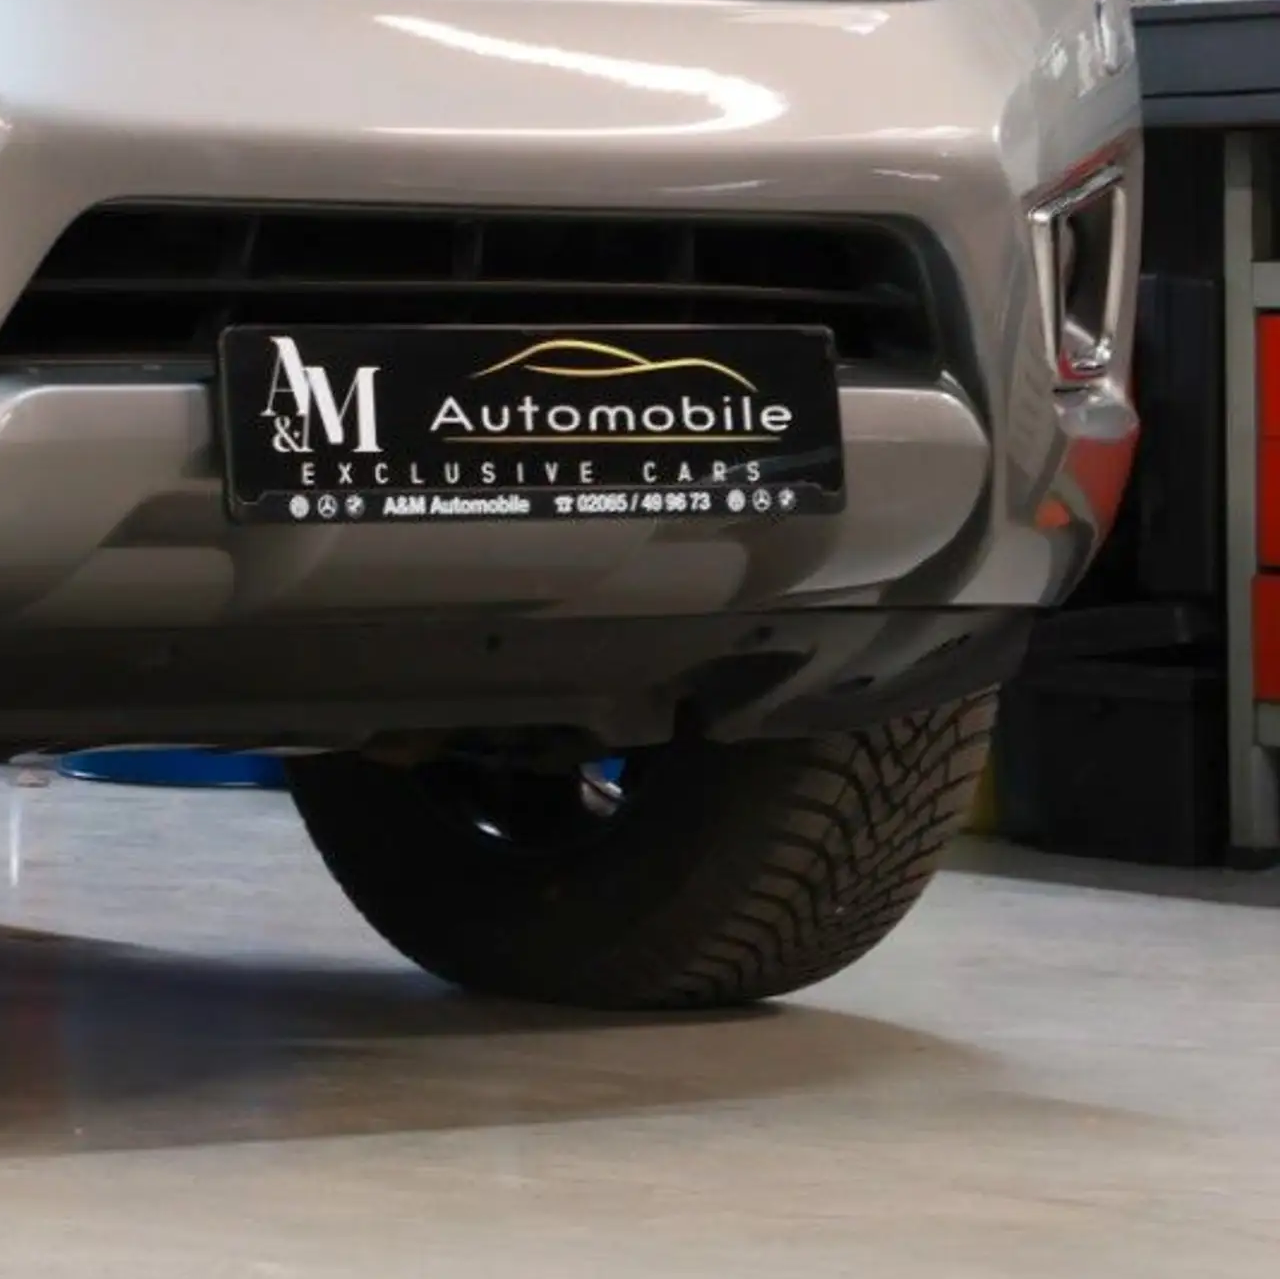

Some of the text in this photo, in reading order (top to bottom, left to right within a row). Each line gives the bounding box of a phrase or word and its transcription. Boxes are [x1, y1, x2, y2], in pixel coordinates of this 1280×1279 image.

[429, 395, 793, 434] Automobile
[300, 461, 761, 485] EXCLUSIVE CARS
[383, 494, 427, 516] A&M
[429, 493, 531, 516] Automobile
[690, 491, 712, 512] 73
